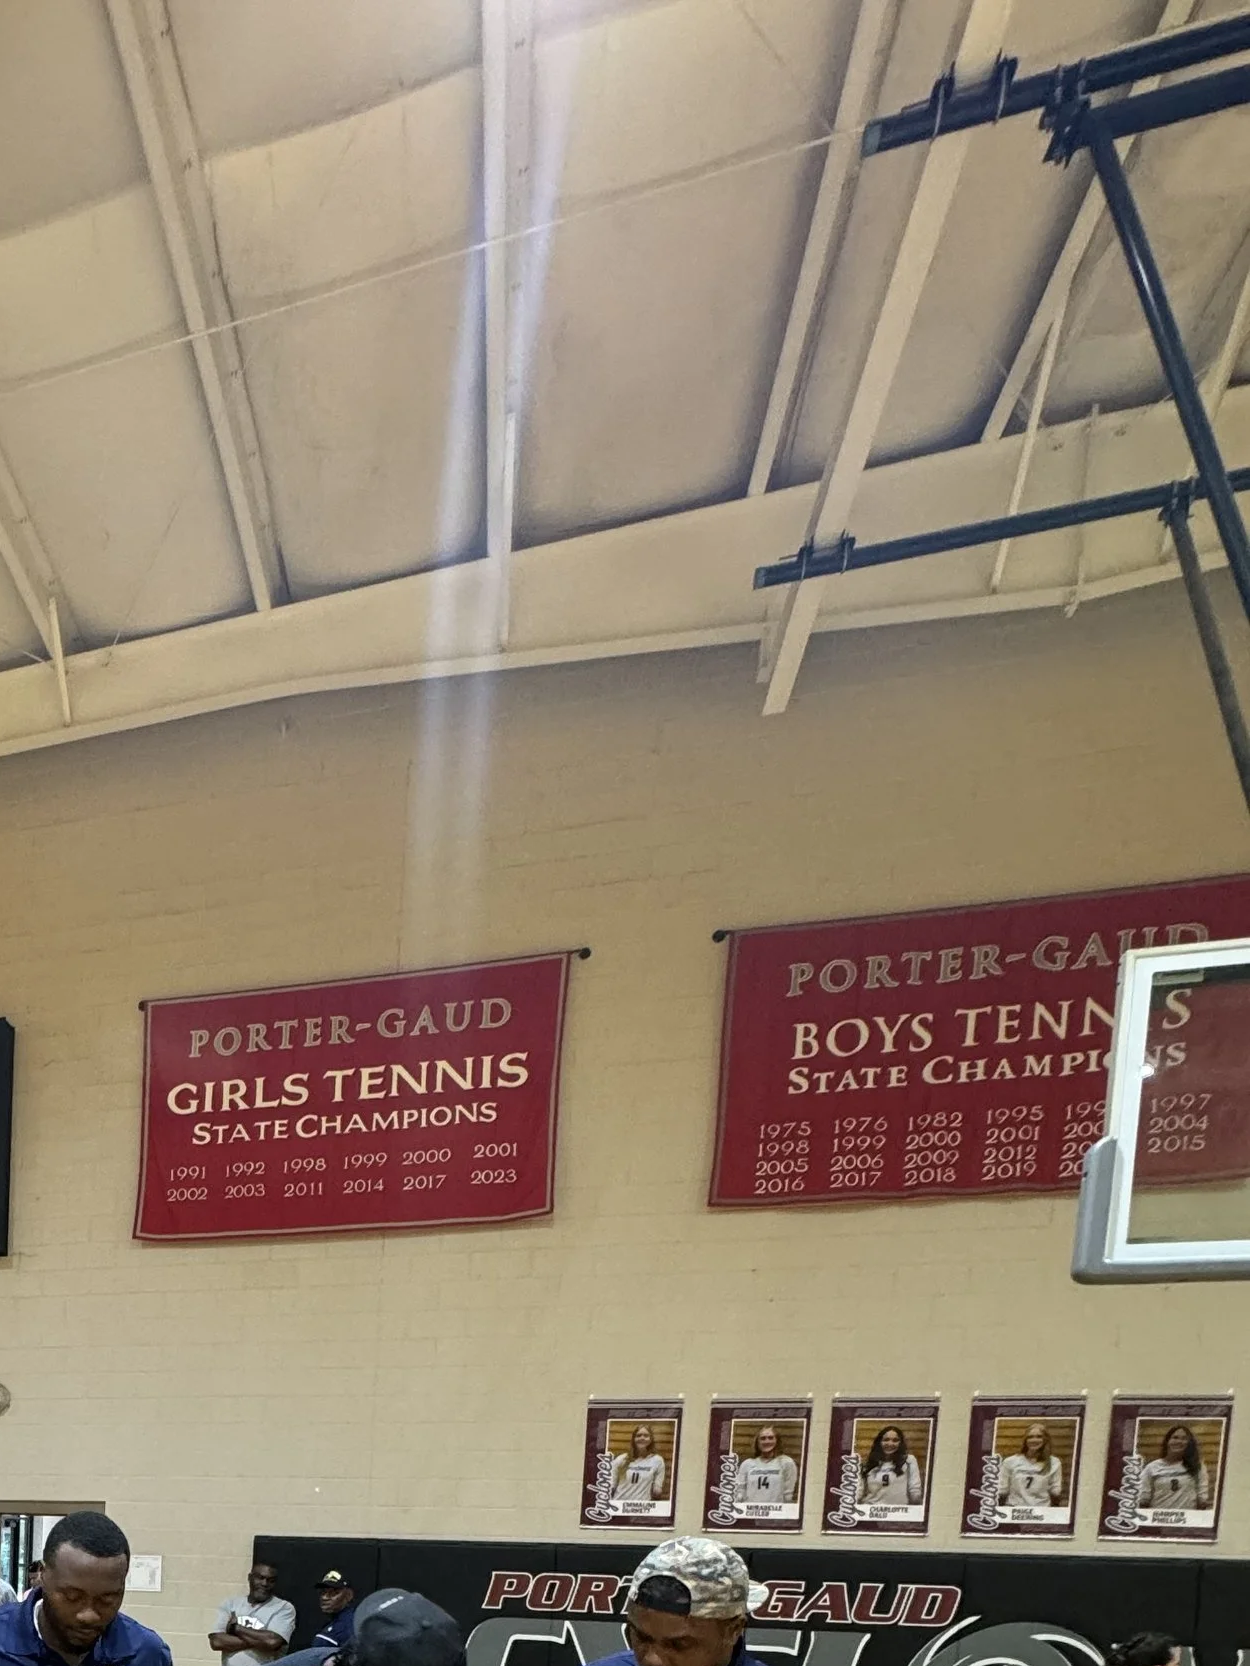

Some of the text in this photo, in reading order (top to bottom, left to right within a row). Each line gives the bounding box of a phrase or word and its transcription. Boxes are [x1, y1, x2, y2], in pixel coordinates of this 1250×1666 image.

[188, 997, 512, 1058] PORTER-GAUD
[792, 988, 1192, 1060] BOYS TENNS
[166, 1051, 529, 1116] GIRLS TENNIS
[788, 1065, 908, 1095] STATE
[192, 1102, 498, 1146] STATE CHAMPIONS
[758, 1140, 810, 1157] 1998
[832, 1135, 886, 1153] 1999
[906, 1130, 962, 1150] 2000
[985, 1124, 1040, 1145] 2001
[1149, 1114, 1209, 1134] 2004
[760, 1093, 1212, 1139] 1975 1976 1982 1995 199 1997
[169, 1142, 517, 1181] 1991 1992 1998 1999 2000 2001
[754, 1176, 805, 1194] 2016
[830, 1171, 882, 1188] 2017
[903, 1167, 956, 1187] 2018
[981, 1161, 1037, 1181] 2019
[755, 1158, 809, 1176] 2005
[829, 1153, 884, 1172] 2006
[903, 1150, 959, 1169] 2009
[982, 1144, 1037, 1164] 2012
[1148, 1134, 1206, 1153] 2015
[166, 1168, 518, 1203] 2002 2003 2011 2014 2017 2023
[585, 1452, 619, 1522] Cyclones
[708, 1452, 743, 1526] Cyclones
[757, 1476, 769, 1490] 14
[827, 1453, 865, 1527] Cyclones
[967, 1453, 1007, 1531] Cyclones
[1105, 1454, 1148, 1533] Cyclones
